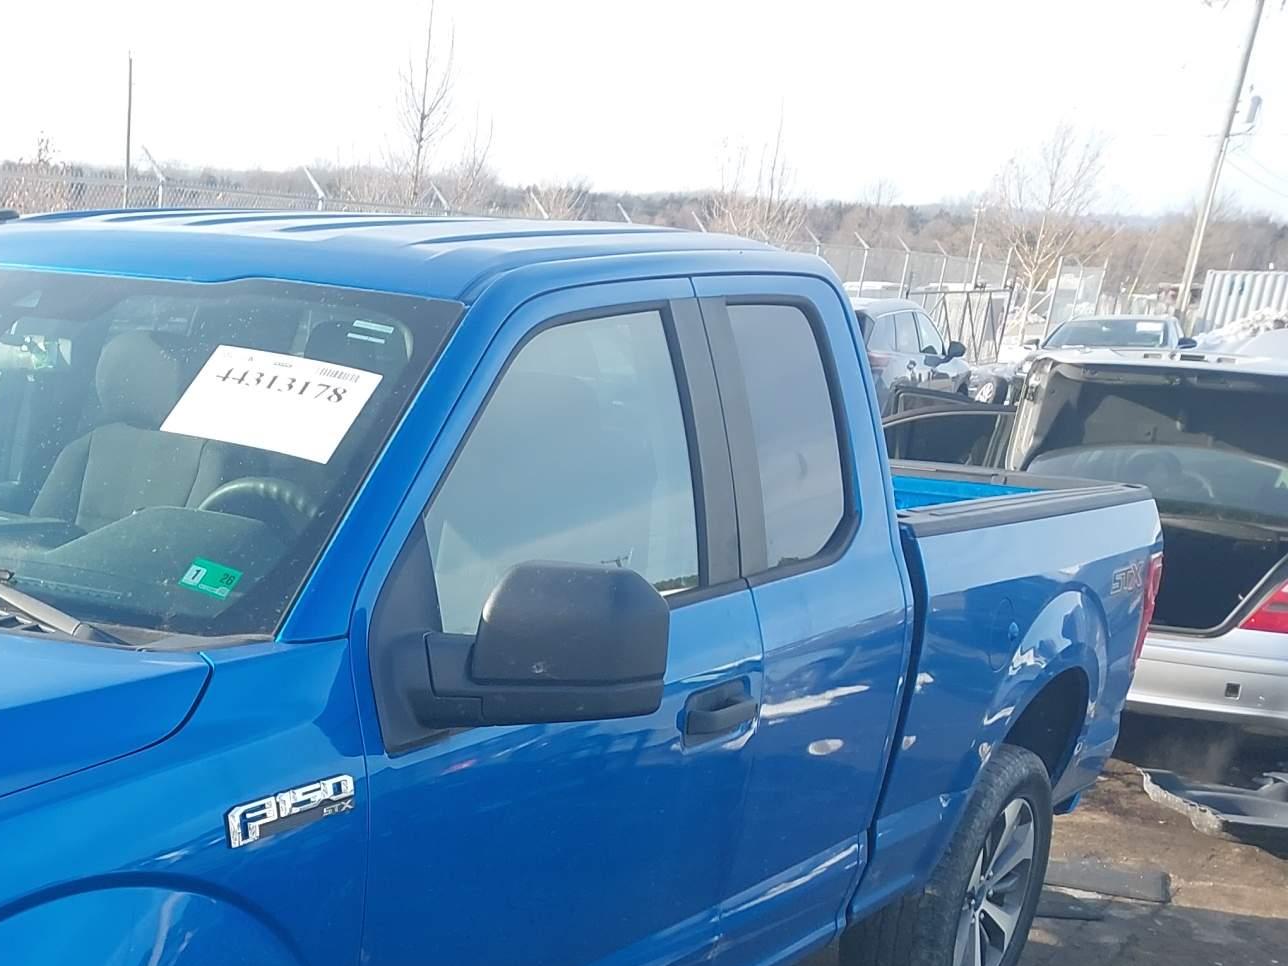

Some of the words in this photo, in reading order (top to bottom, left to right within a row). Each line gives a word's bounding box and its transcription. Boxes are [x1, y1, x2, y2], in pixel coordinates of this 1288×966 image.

[215, 367, 348, 404] 44313178
[191, 569, 202, 580] 1
[1110, 560, 1145, 595] STX
[322, 798, 355, 817] STX
